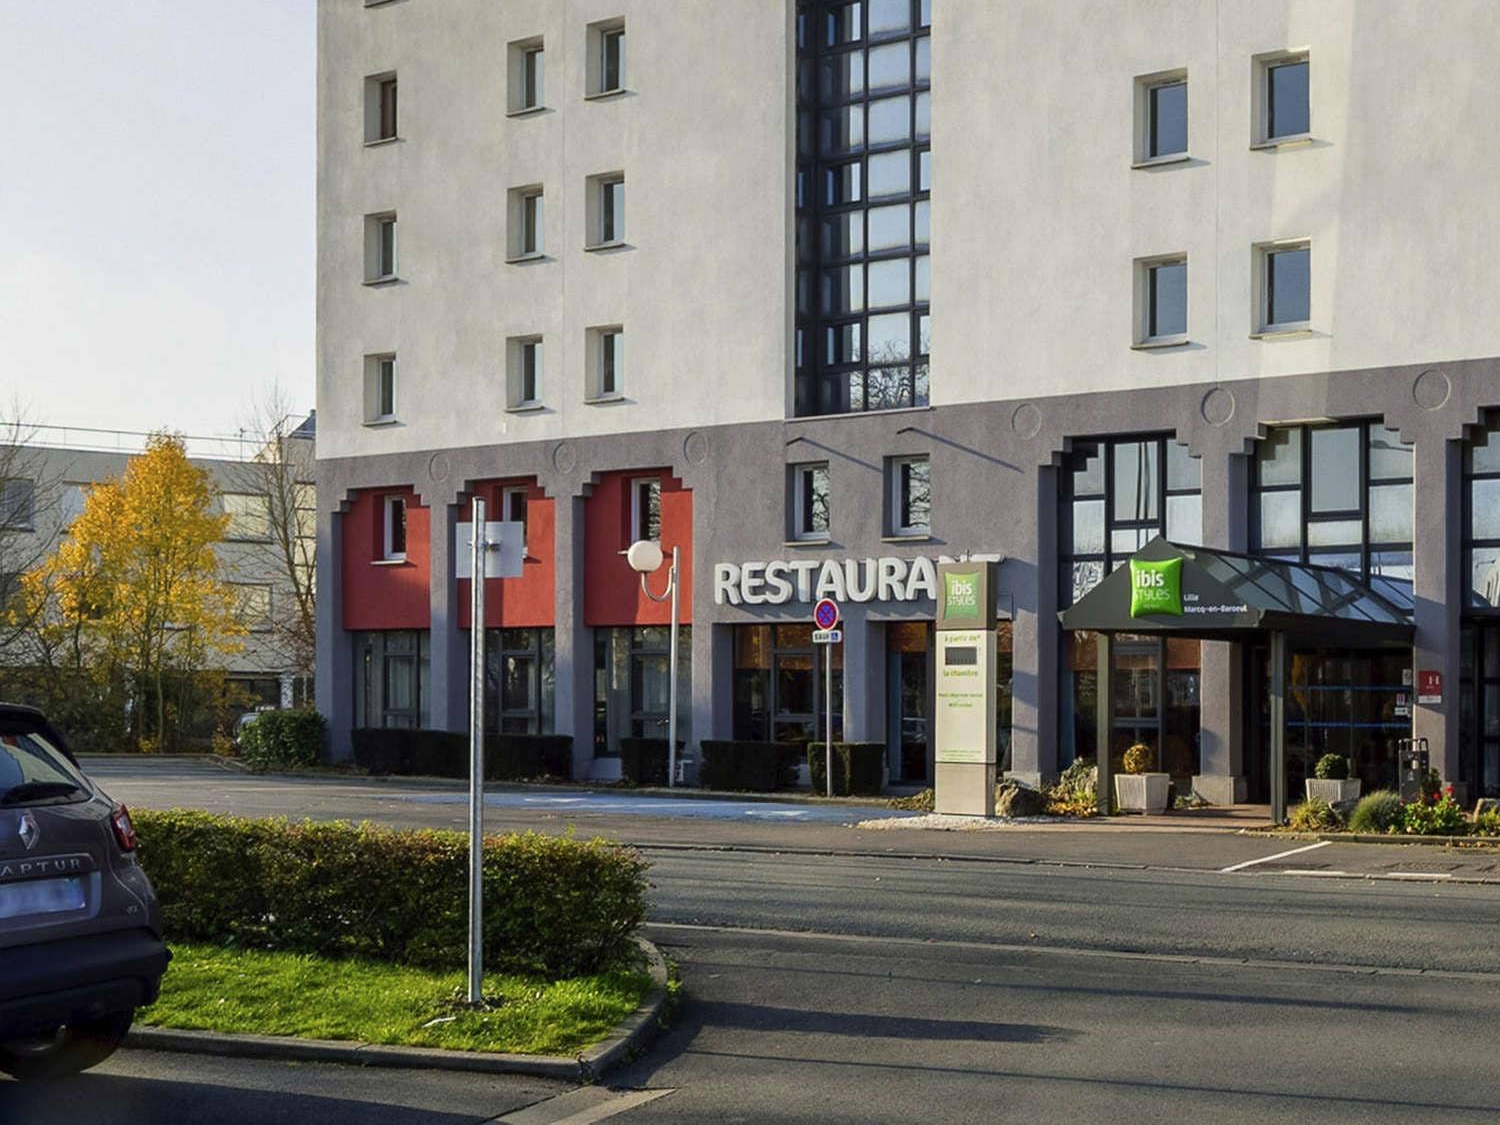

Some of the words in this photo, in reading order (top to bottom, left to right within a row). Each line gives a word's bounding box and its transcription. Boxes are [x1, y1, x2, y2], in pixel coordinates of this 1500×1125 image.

[712, 554, 1004, 605] RESTAURA
[951, 579, 973, 596] ibis
[1135, 569, 1165, 588] ibis
[0, 858, 81, 876] APTUR
